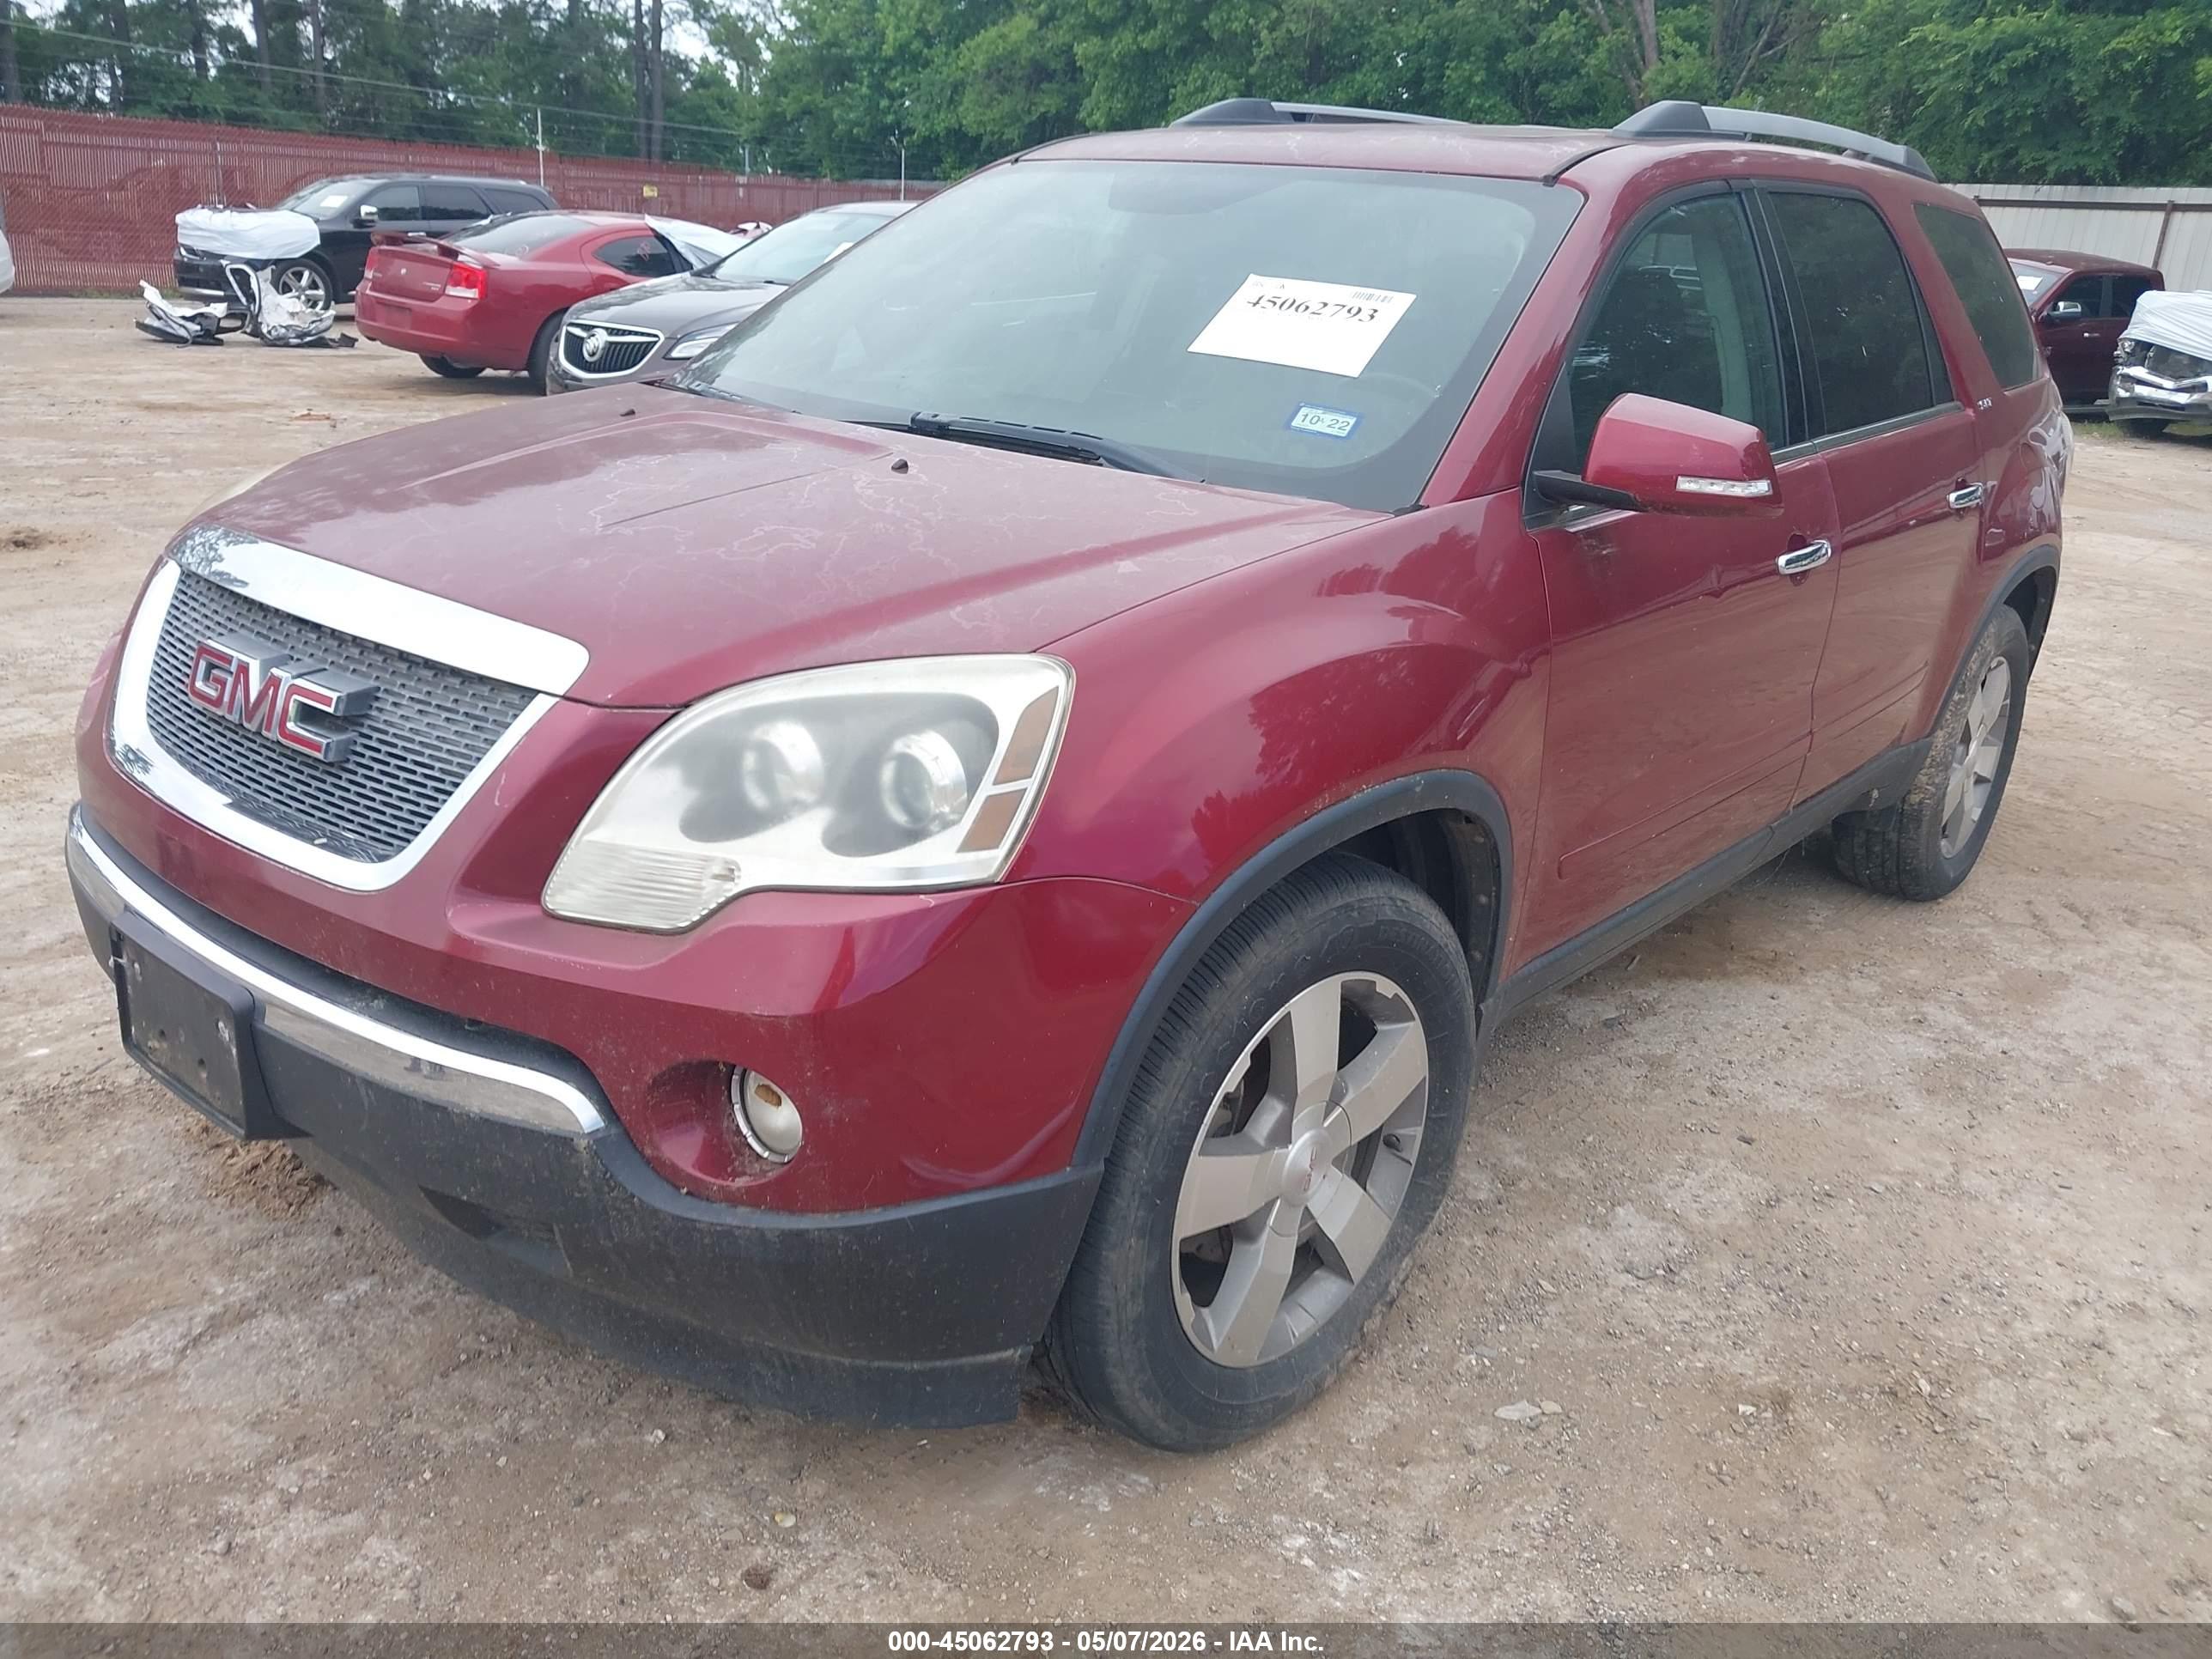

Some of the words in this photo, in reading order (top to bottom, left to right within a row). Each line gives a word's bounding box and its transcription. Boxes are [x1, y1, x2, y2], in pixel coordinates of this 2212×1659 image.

[1246, 294, 1379, 324] 45062793
[1301, 413, 1321, 425] 10
[1327, 418, 1351, 431] 22
[188, 641, 342, 761] GMC
